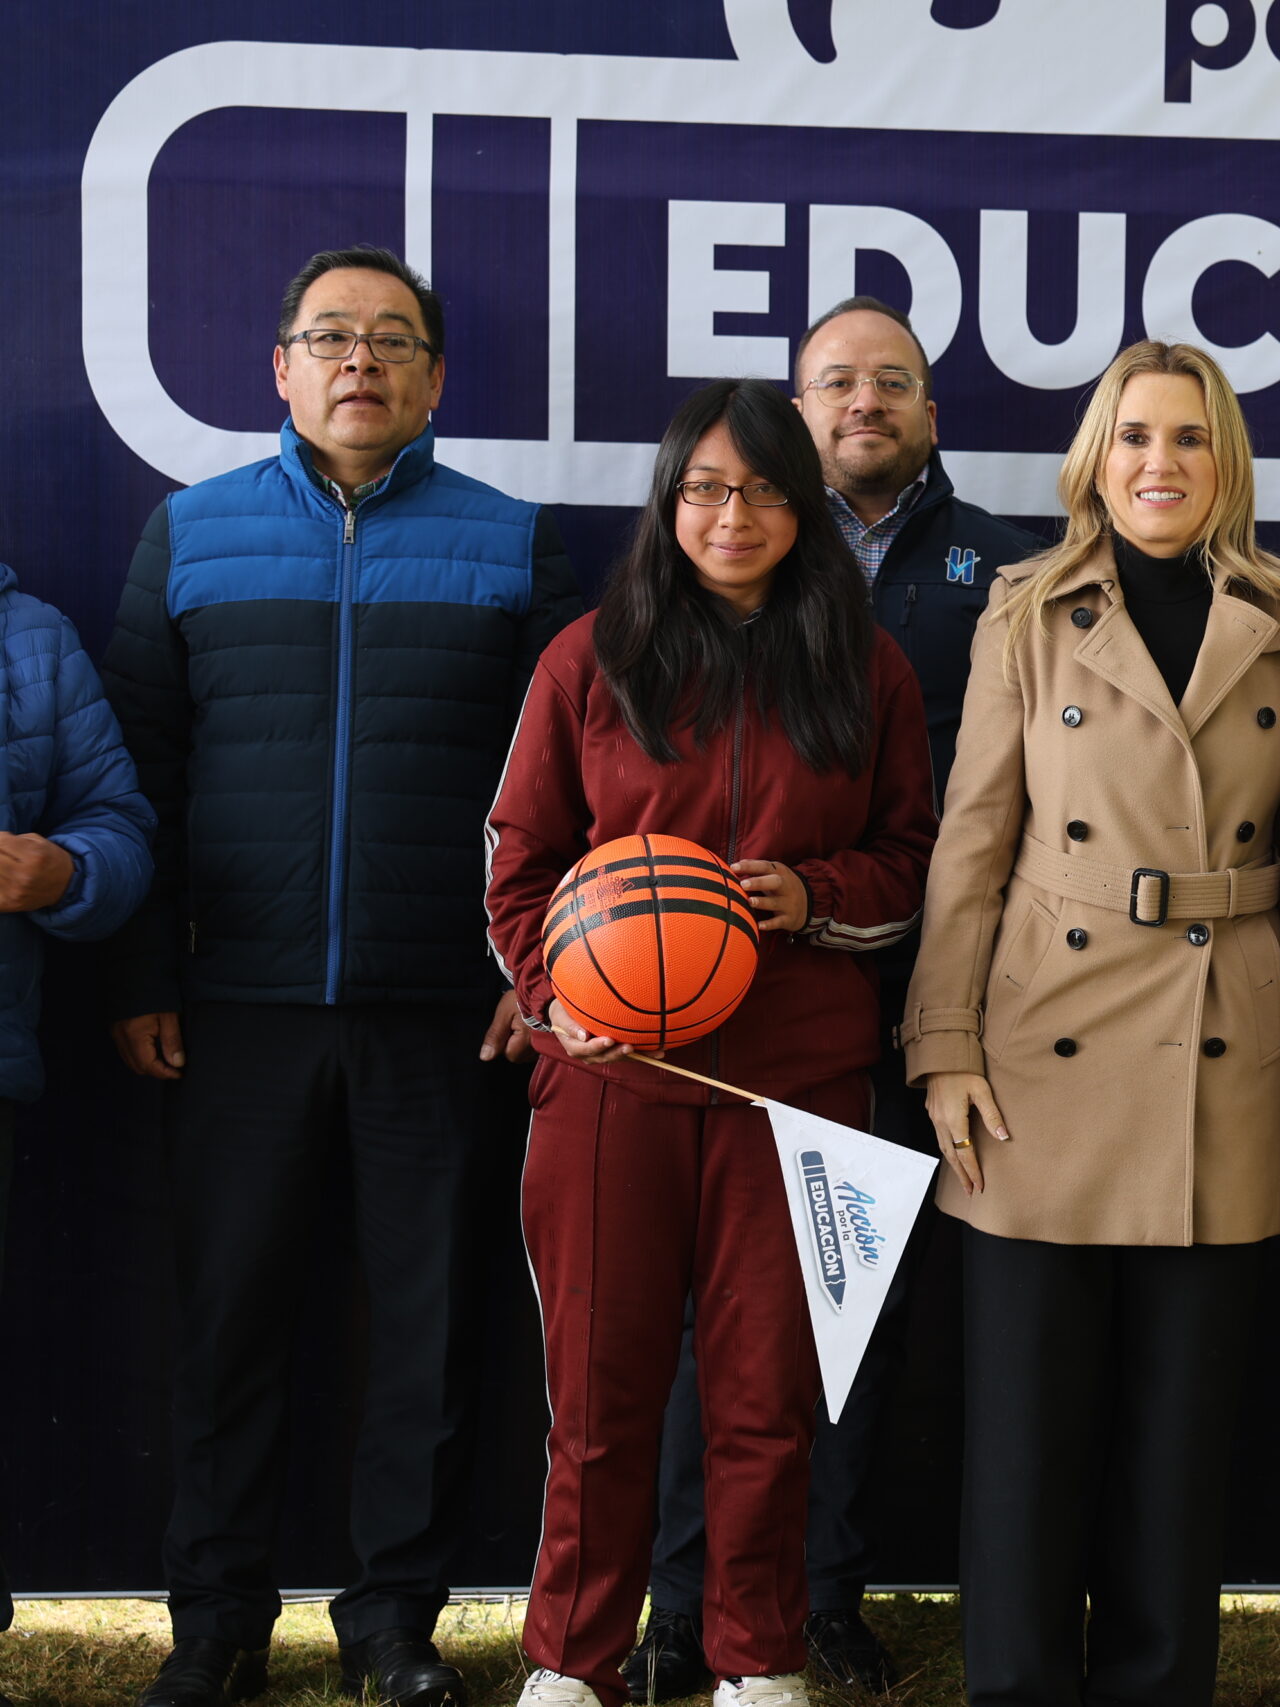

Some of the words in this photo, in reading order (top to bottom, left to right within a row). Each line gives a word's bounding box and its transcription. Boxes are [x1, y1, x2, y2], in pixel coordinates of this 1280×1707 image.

[810, 1181, 841, 1276] EDUCACIÓN
[834, 1181, 885, 1265] Acción
[836, 1209, 848, 1228] por
[842, 1229, 851, 1241] la
